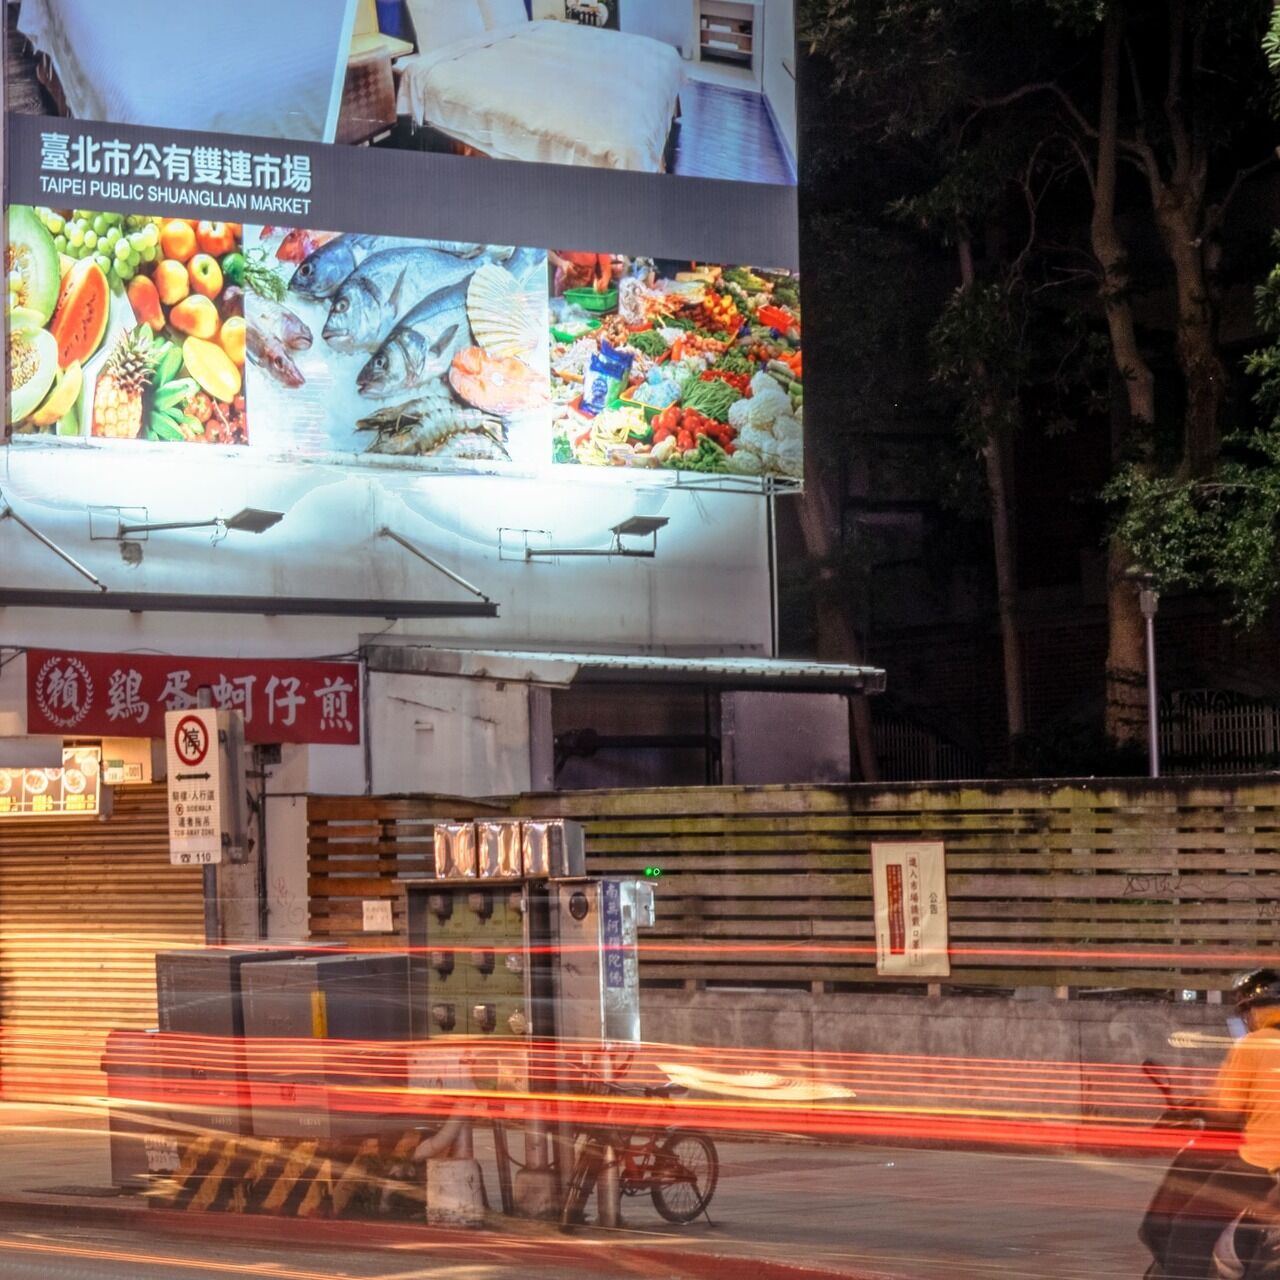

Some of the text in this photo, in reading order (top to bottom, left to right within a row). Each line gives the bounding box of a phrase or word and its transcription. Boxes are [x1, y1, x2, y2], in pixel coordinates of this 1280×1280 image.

[40, 132, 311, 193] 臺北市公有雙連市場
[40, 176, 86, 195] TAIPEI
[90, 180, 144, 201] PUBLIC
[250, 195, 311, 215] MARKET
[47, 669, 82, 713] 賴
[196, 853, 211, 862] 110
